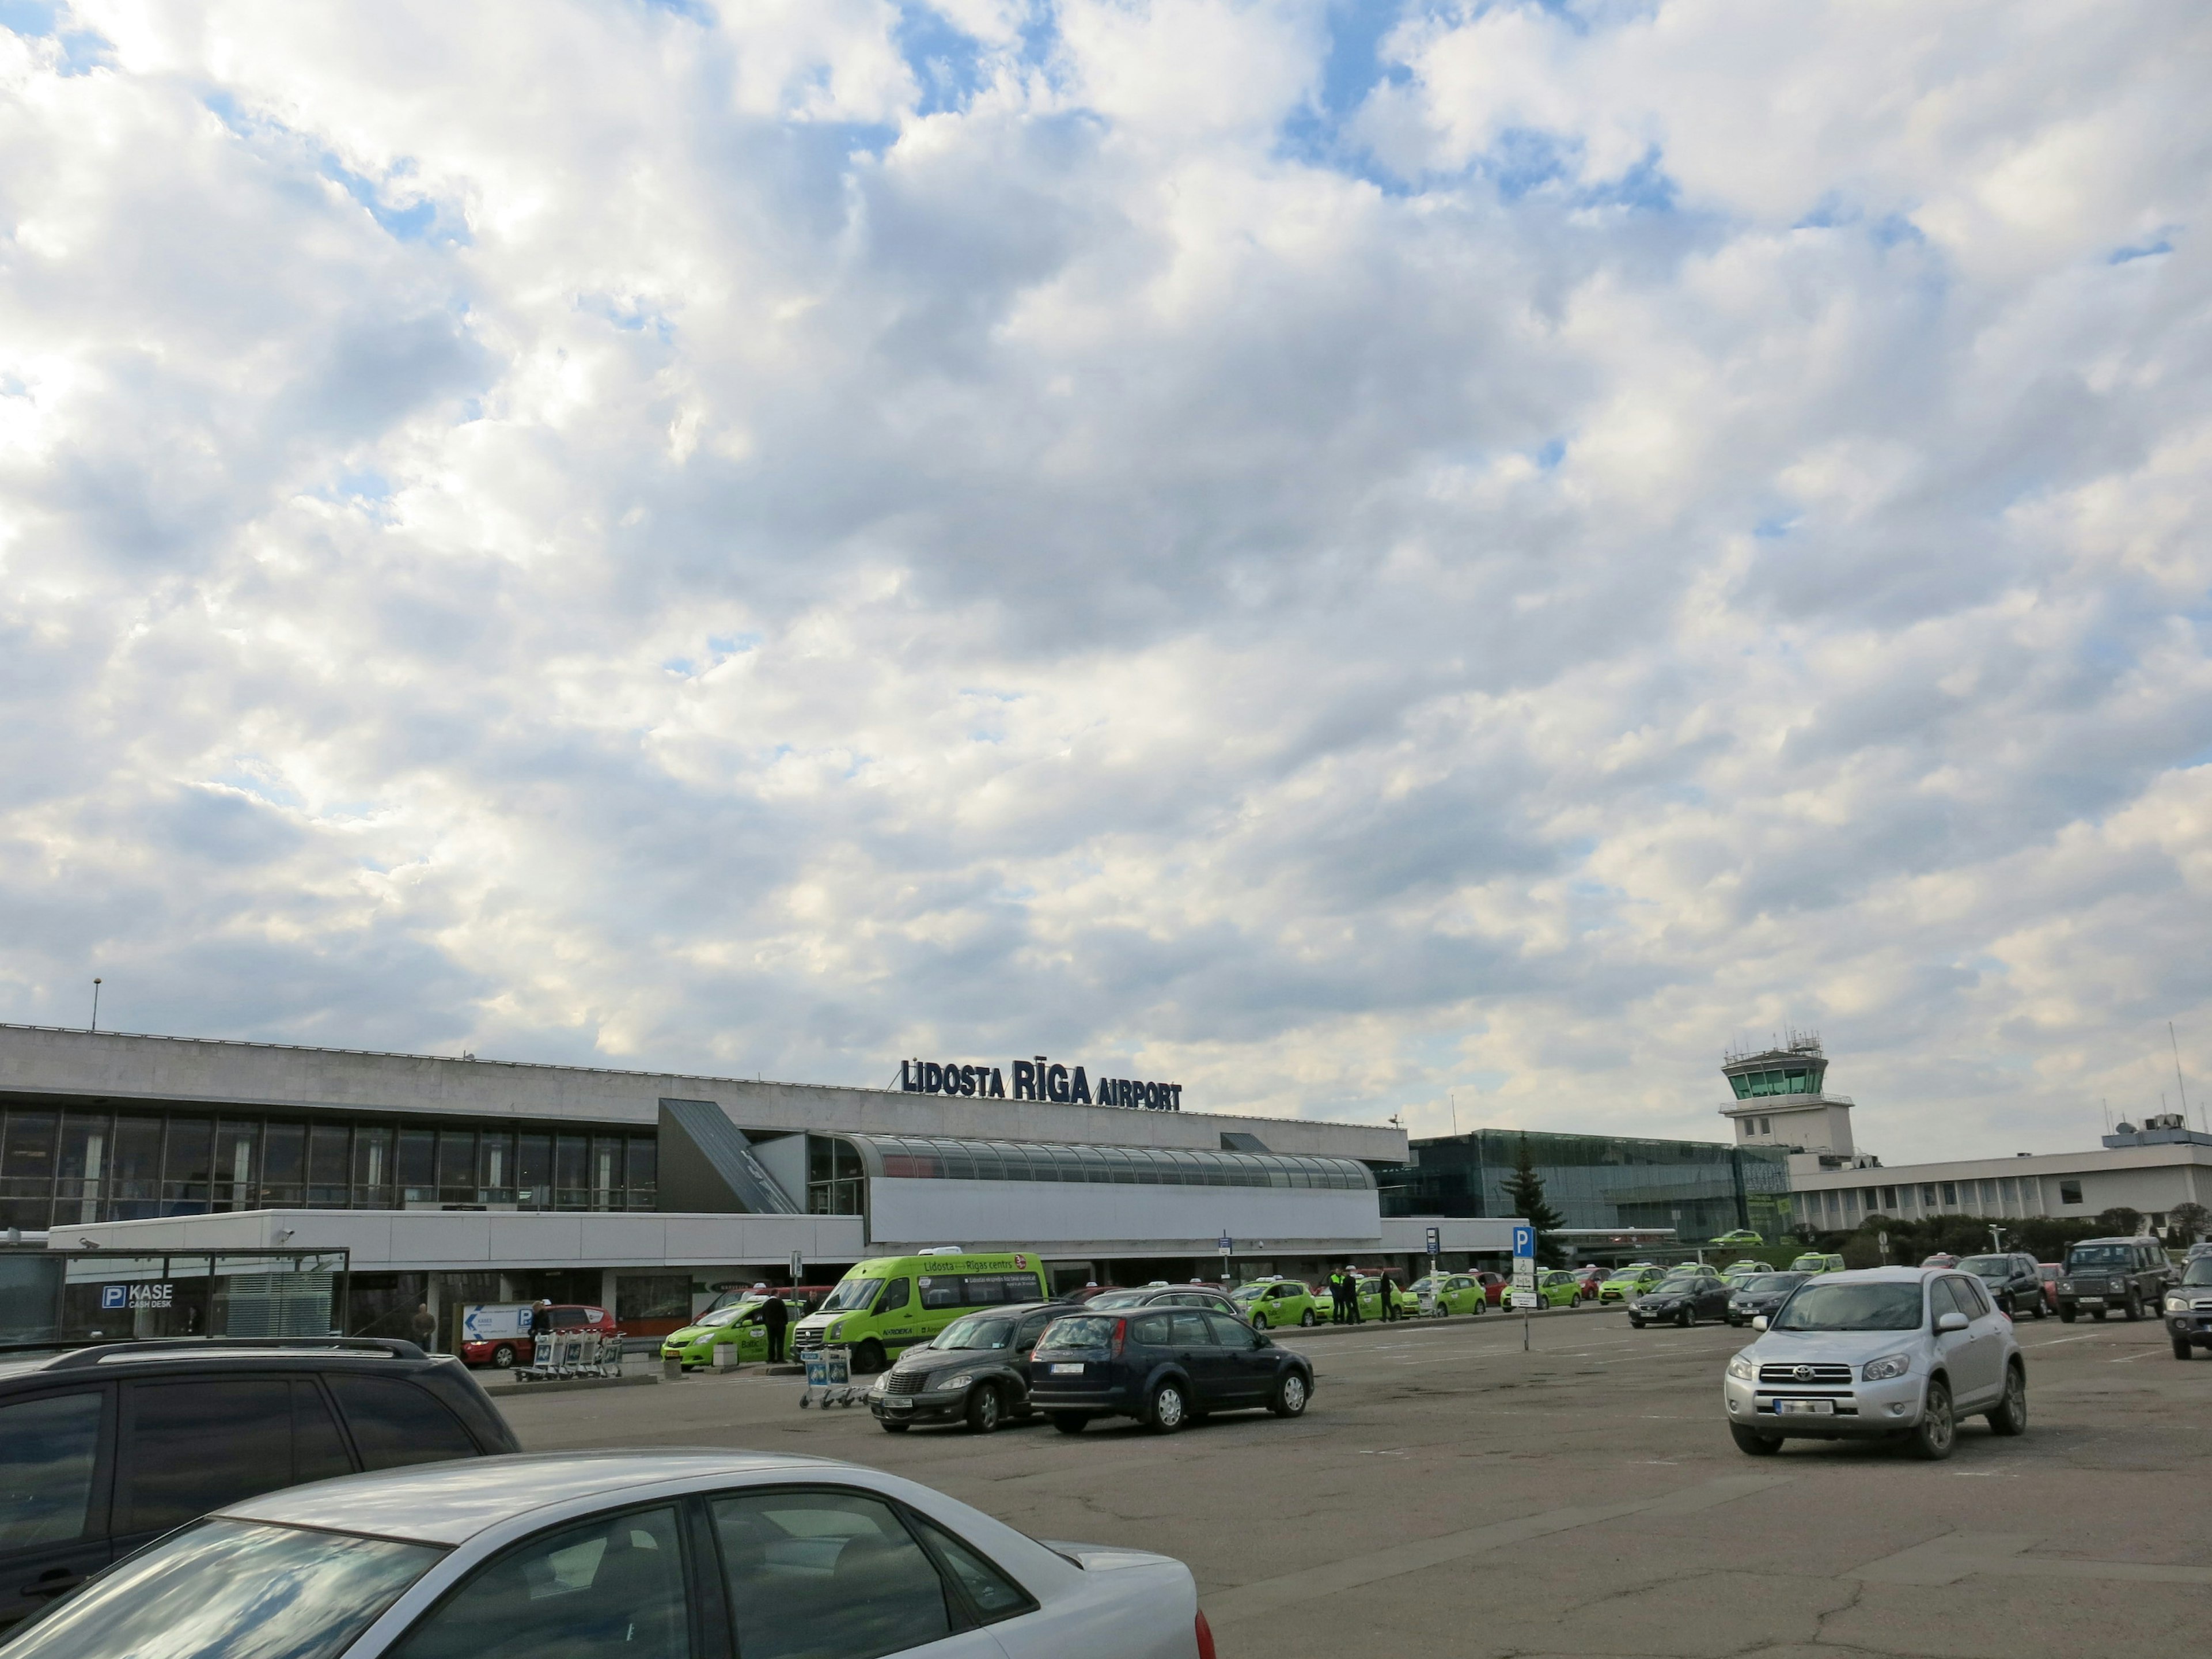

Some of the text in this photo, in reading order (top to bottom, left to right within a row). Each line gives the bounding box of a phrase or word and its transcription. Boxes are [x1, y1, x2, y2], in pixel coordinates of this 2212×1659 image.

[901, 1055, 1182, 1111] LIDOSTA RĪGA AIRPORT
[1517, 1230, 1528, 1253] P
[924, 1261, 955, 1272] Lidosta
[989, 1260, 1013, 1270] centrs
[105, 1288, 122, 1306] P
[129, 1284, 173, 1300] KASE
